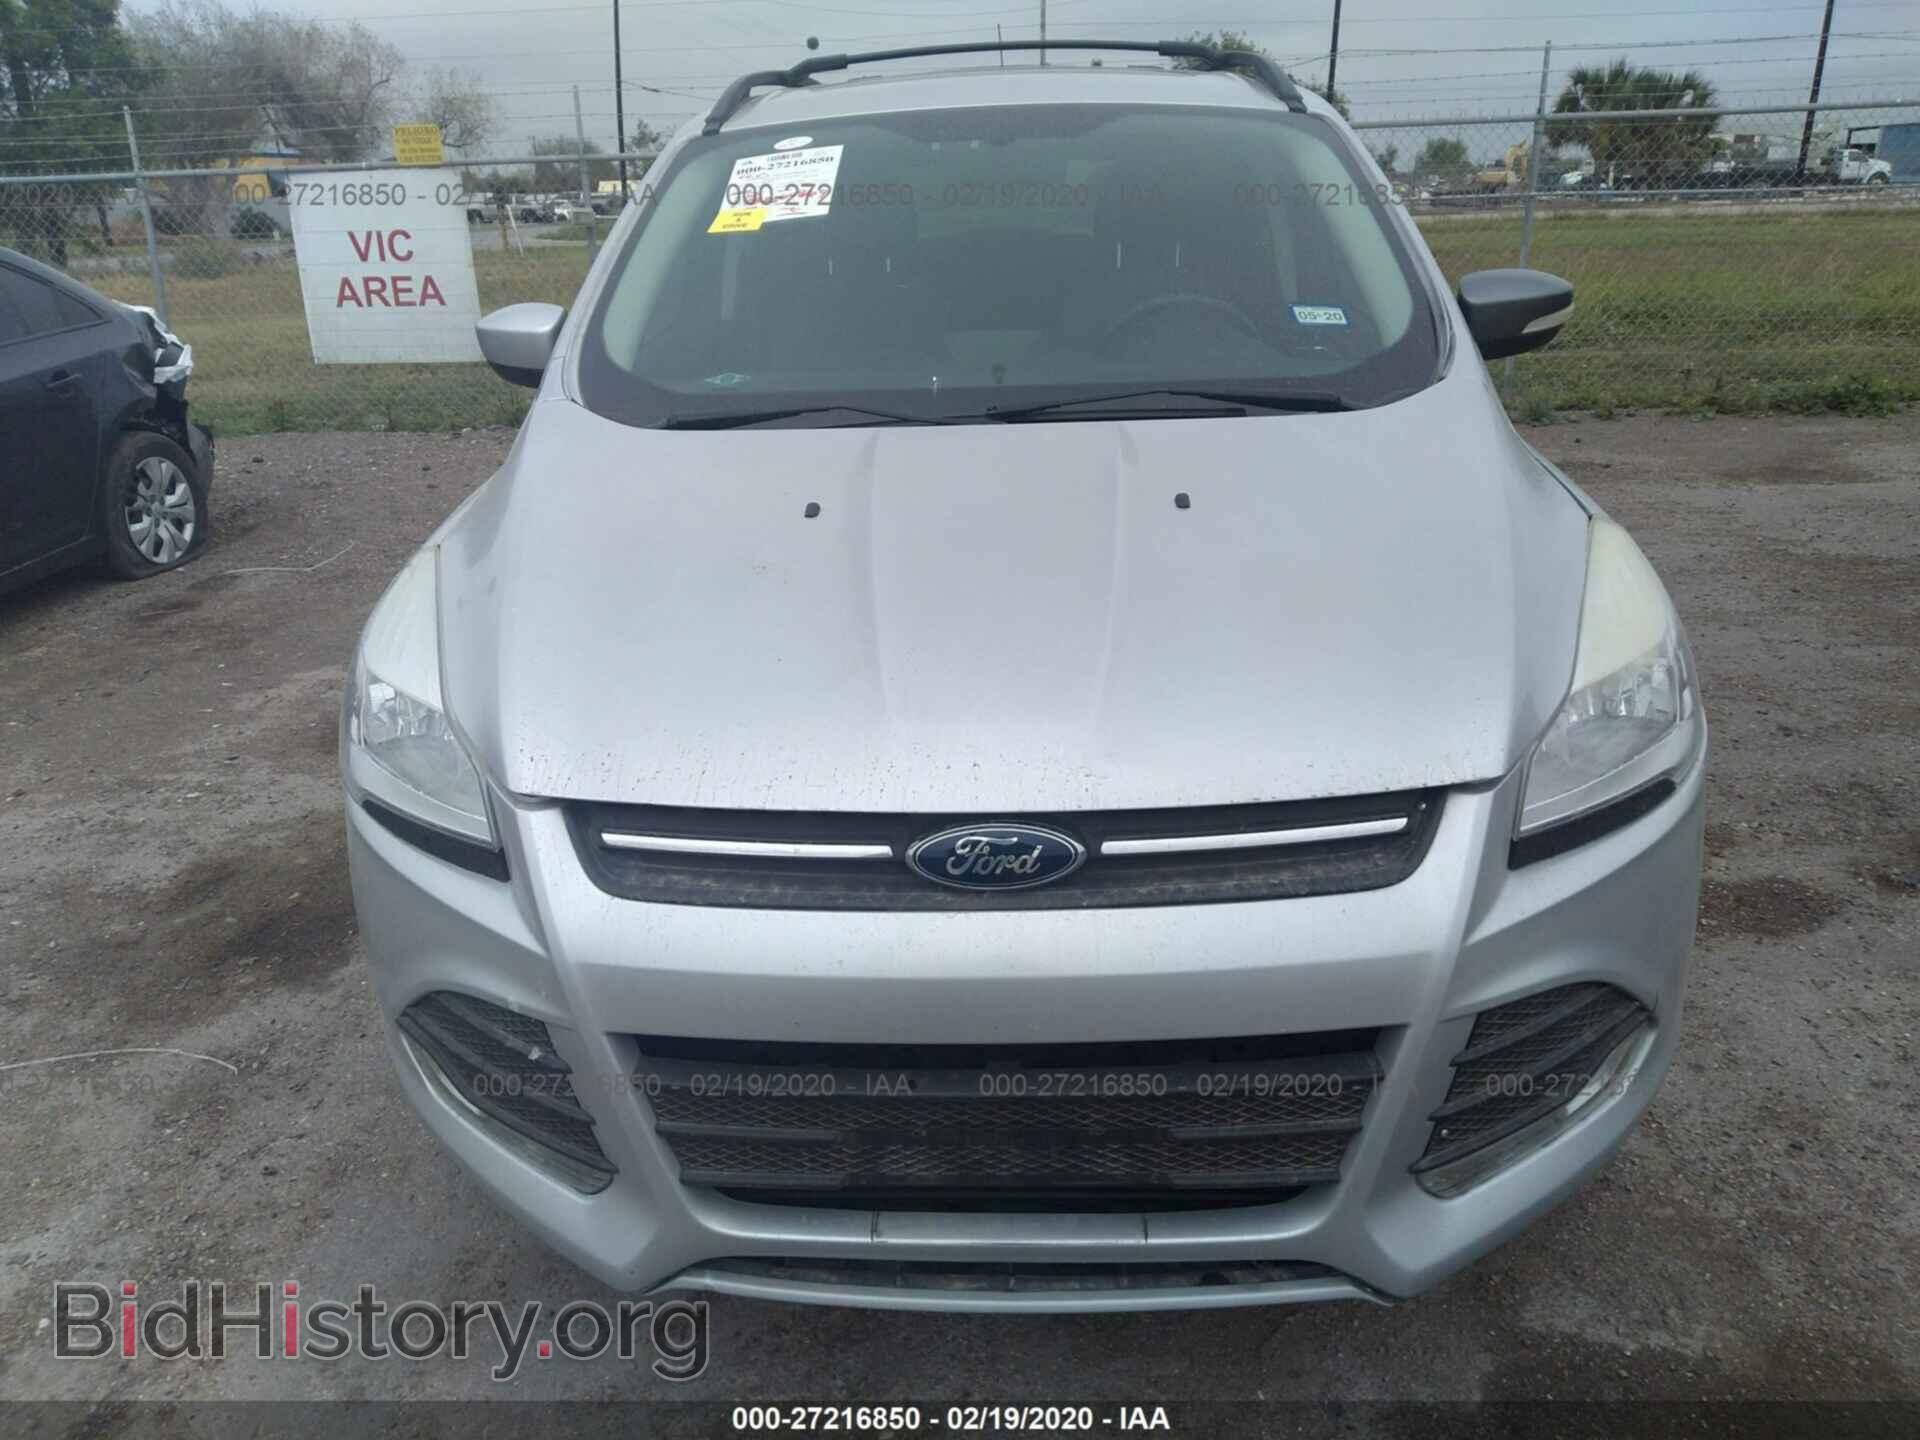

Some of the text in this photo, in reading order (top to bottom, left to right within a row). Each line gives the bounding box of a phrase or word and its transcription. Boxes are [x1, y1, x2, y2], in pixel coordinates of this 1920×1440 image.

[347, 229, 414, 262] VIC
[336, 274, 446, 307] AREA
[946, 835, 1043, 875] Ford
